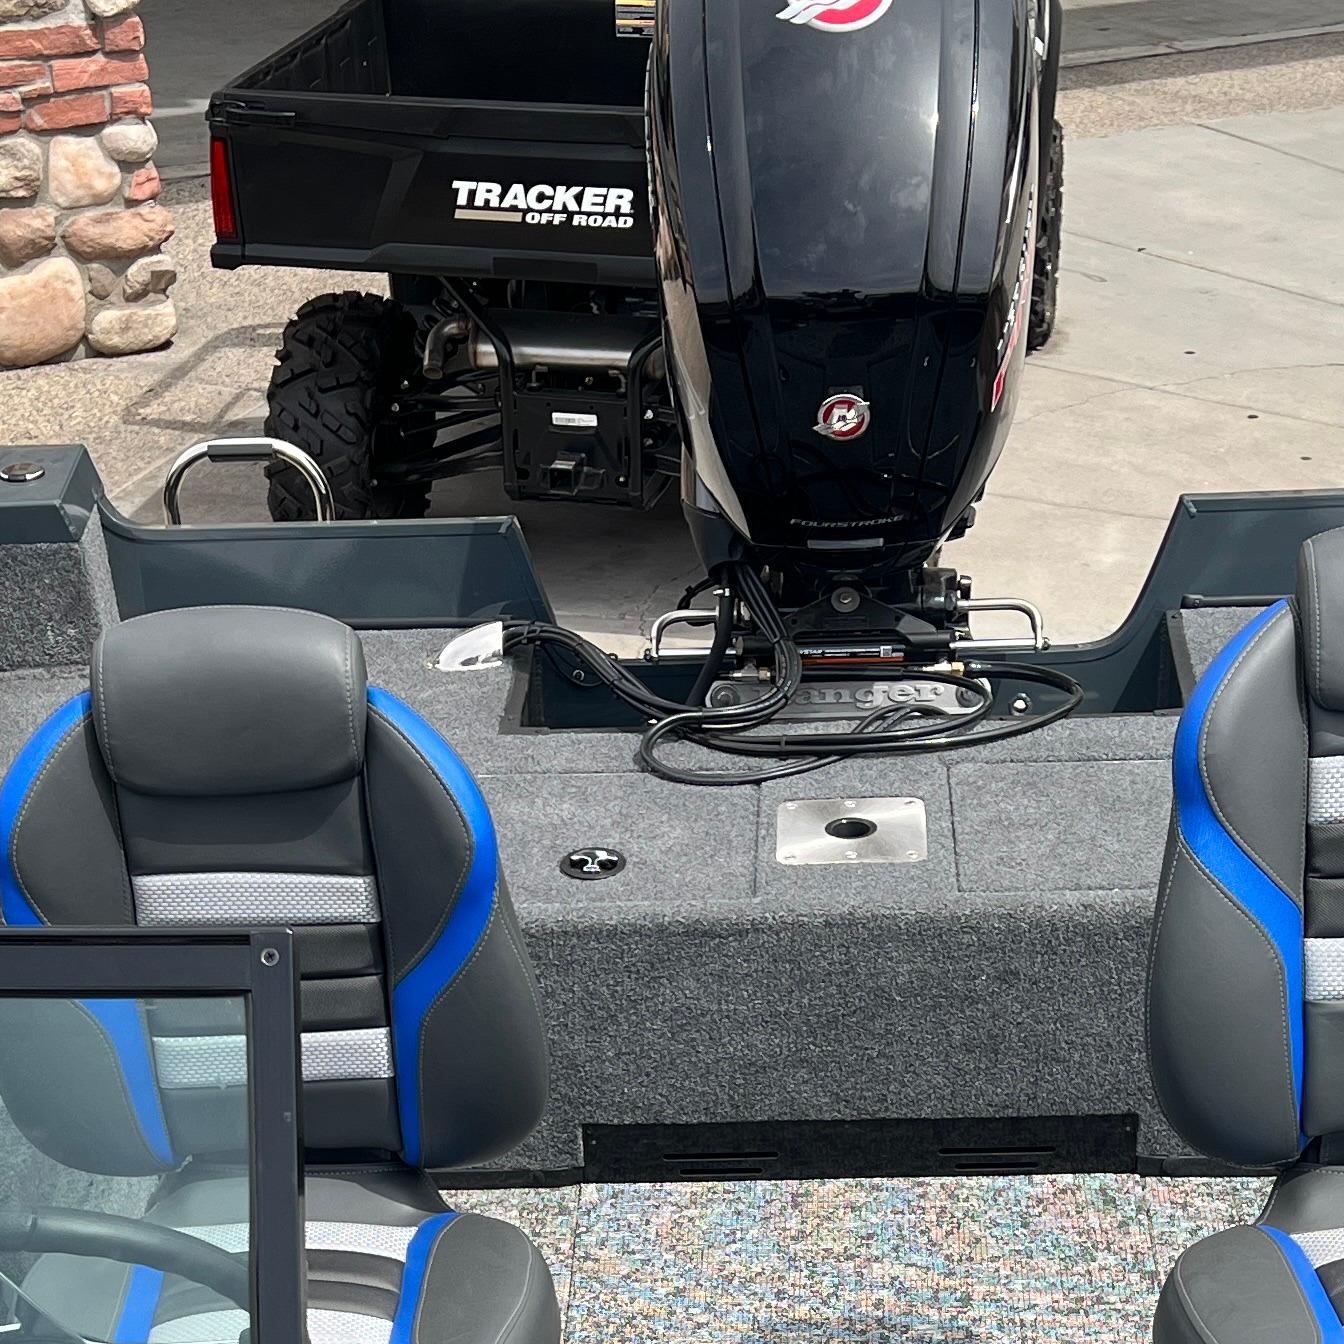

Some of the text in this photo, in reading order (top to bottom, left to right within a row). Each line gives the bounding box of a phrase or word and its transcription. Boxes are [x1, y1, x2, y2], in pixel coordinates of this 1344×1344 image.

[451, 180, 634, 213] TRACKER
[525, 212, 634, 228] OFF ROAD
[789, 514, 905, 528] FOURSTROKE
[766, 683, 945, 709] anger
